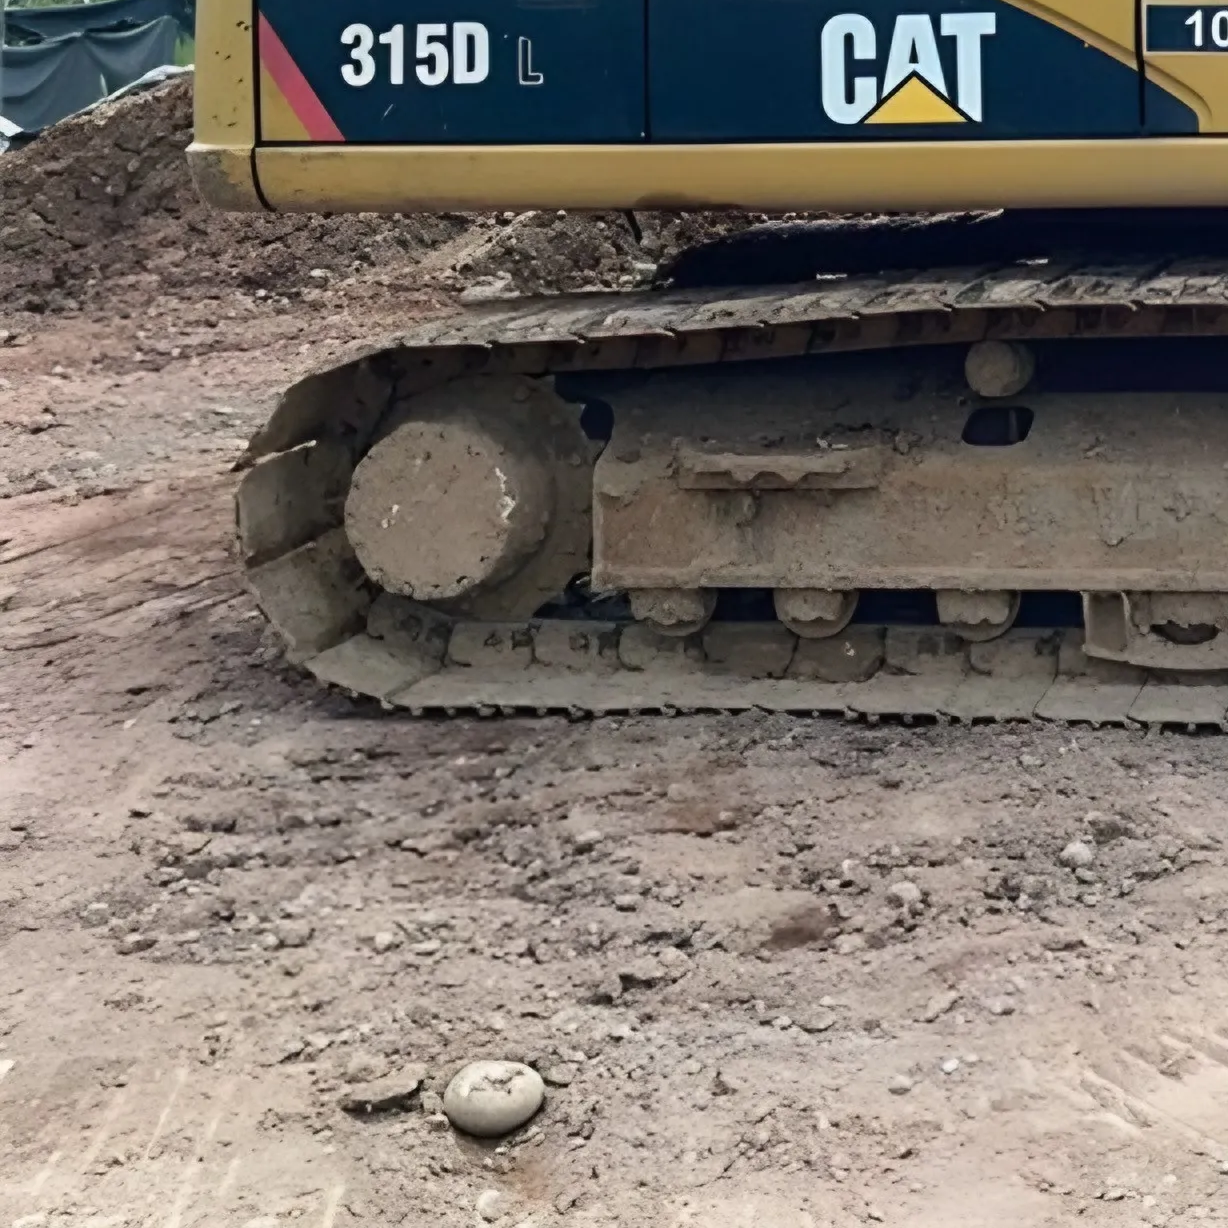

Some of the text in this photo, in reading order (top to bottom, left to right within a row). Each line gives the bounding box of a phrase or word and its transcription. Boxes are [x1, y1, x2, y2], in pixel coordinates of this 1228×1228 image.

[340, 21, 544, 87] 315D L
[820, 12, 996, 125] CAT
